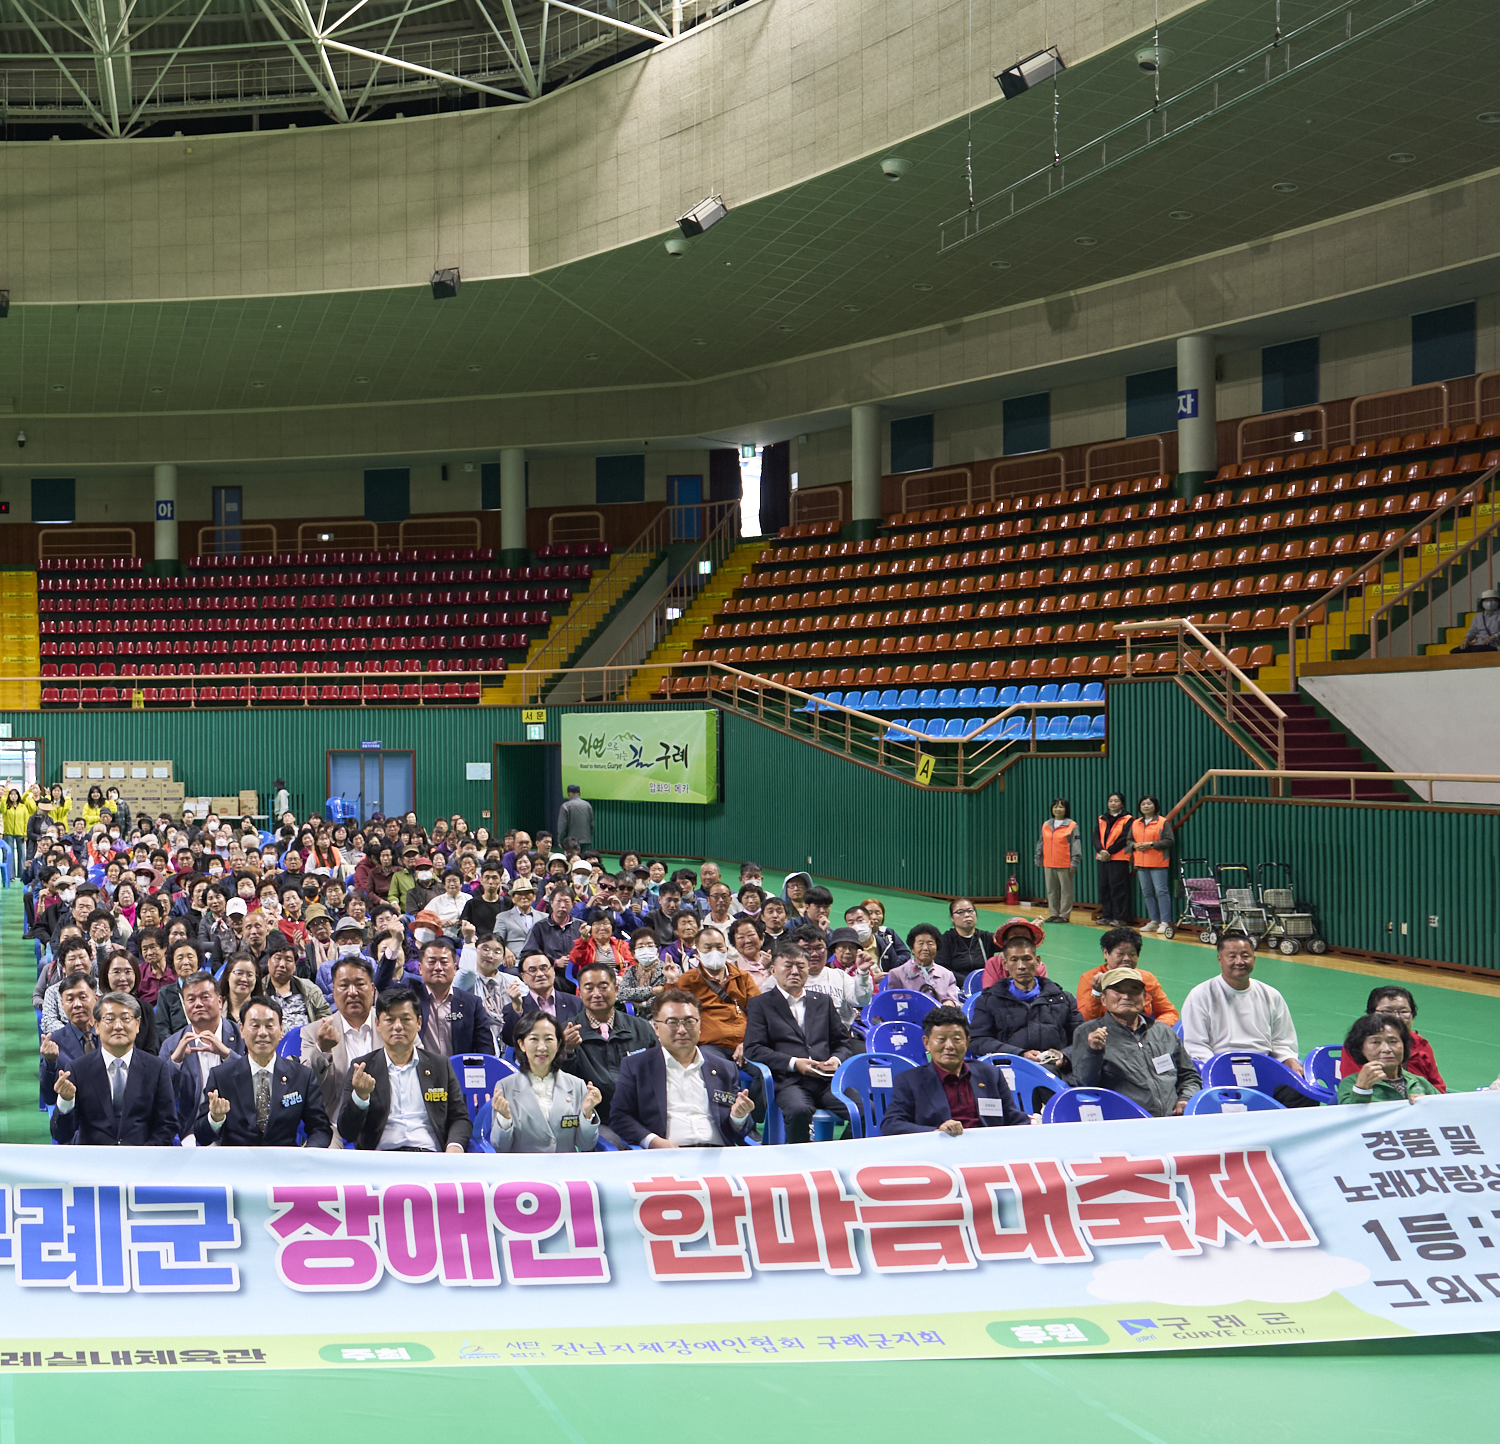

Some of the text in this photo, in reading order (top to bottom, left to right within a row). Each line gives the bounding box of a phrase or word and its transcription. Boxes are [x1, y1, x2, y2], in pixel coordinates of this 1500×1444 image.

[158, 502, 172, 518] 아
[579, 732, 607, 758] 자연
[655, 741, 688, 770] 구례
[919, 759, 930, 778] A
[649, 783, 690, 794] 압화의 메카
[1361, 1124, 1485, 1161] 경품 및
[270, 1179, 605, 1285] 장애인
[633, 1150, 1309, 1275] 한마음대축제
[551, 1330, 947, 1357] 전남지체장애인협회 구례군지회
[1010, 1322, 1089, 1345] 후원
[1172, 1324, 1306, 1341] GURYE County
